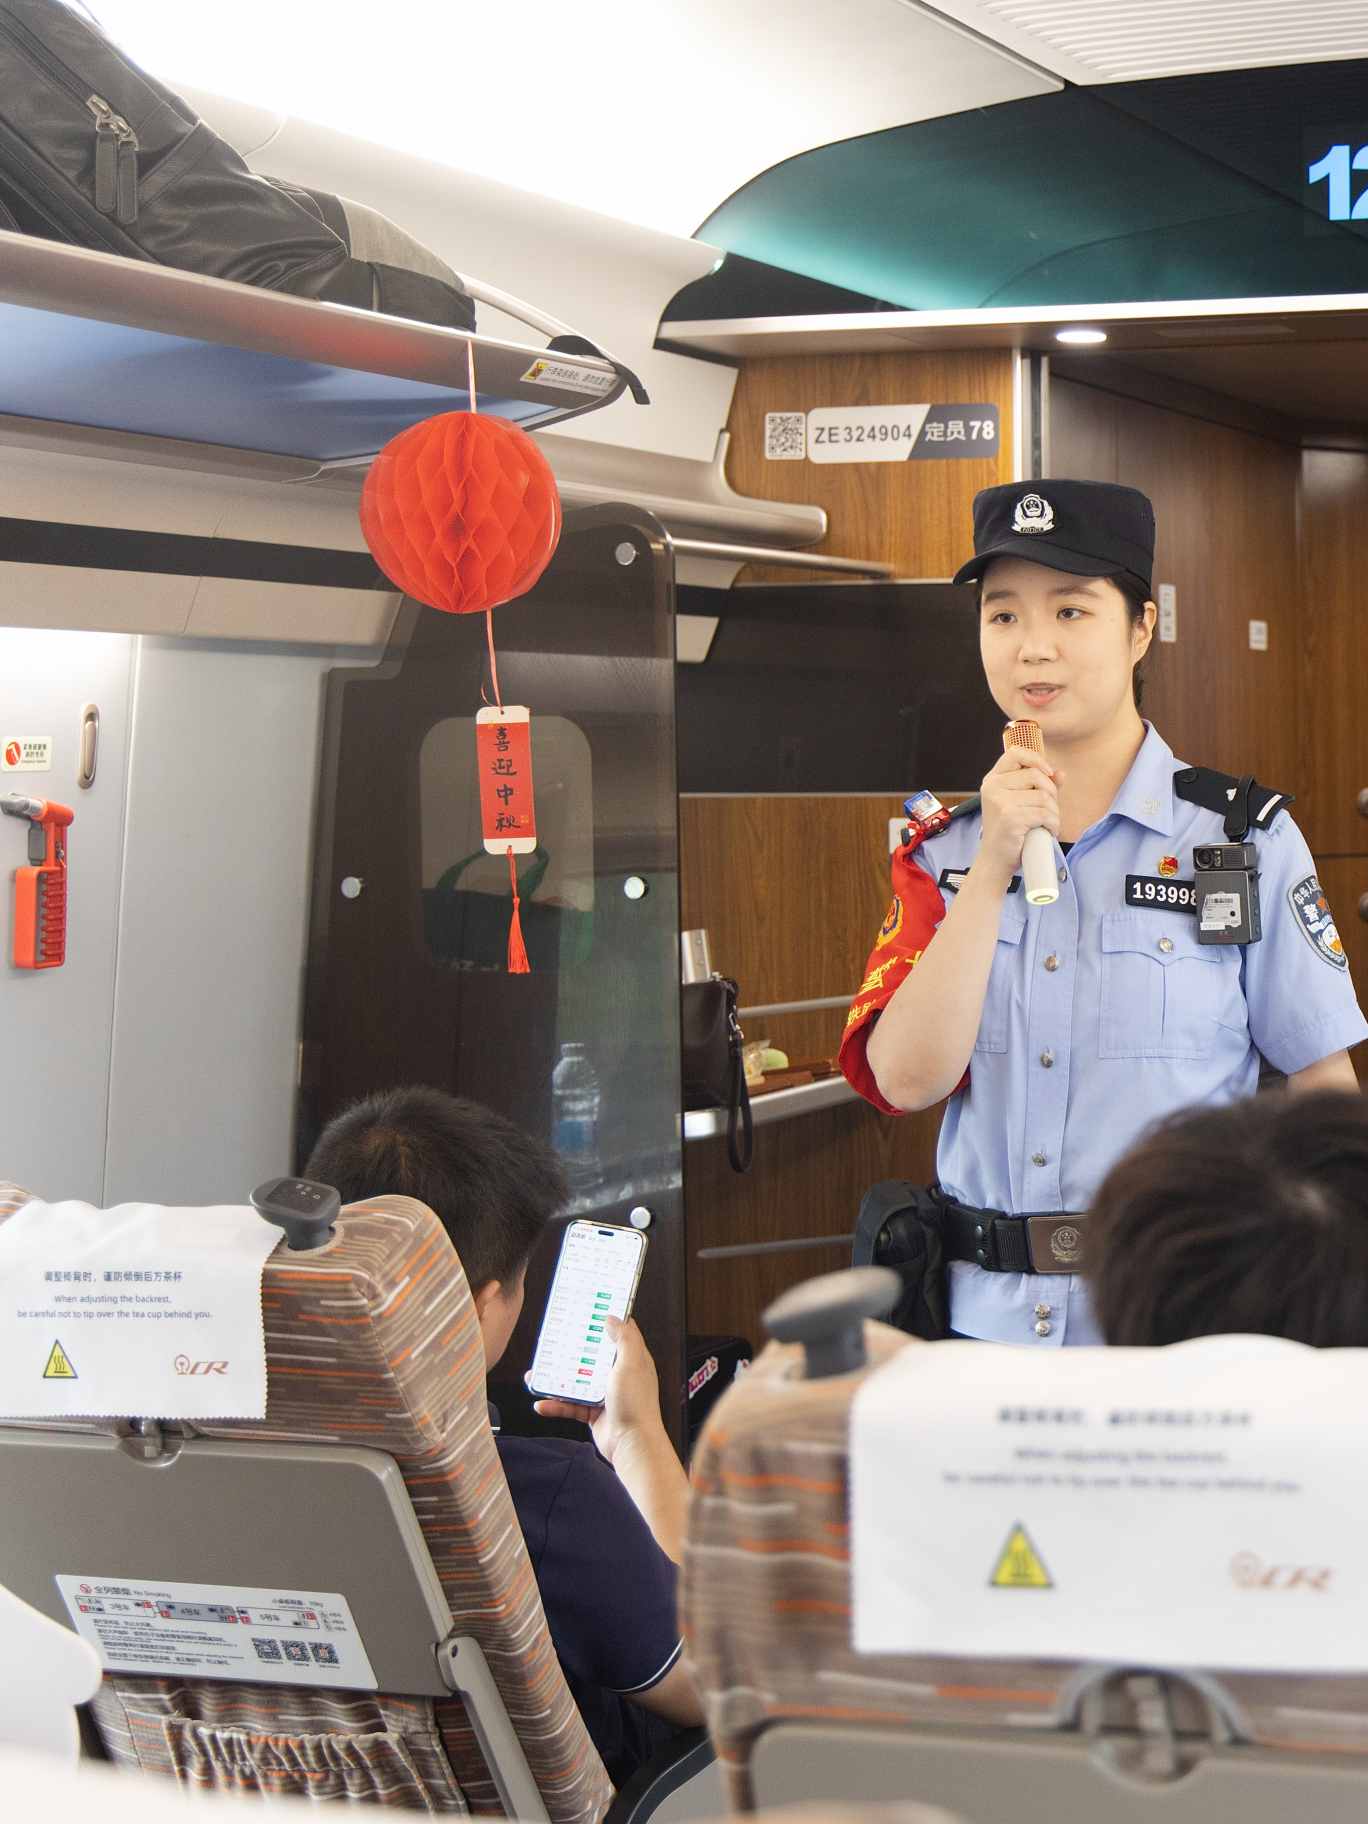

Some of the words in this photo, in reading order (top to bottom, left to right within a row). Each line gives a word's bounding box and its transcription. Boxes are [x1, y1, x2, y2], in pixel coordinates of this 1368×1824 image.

[815, 425, 912, 444] ZE324904
[491, 727, 521, 832] 喜迎中秋
[54, 1294, 78, 1304] When
[79, 1294, 119, 1306] adjusting
[120, 1294, 134, 1304] the
[17, 1310, 28, 1319] be
[29, 1310, 57, 1319] careful
[58, 1311, 72, 1319] not
[73, 1311, 82, 1319] to
[83, 1310, 95, 1321] tip
[117, 1310, 131, 1319] the
[132, 1311, 146, 1319] tea
[147, 1312, 162, 1321] cup
[164, 1310, 192, 1319] behind
